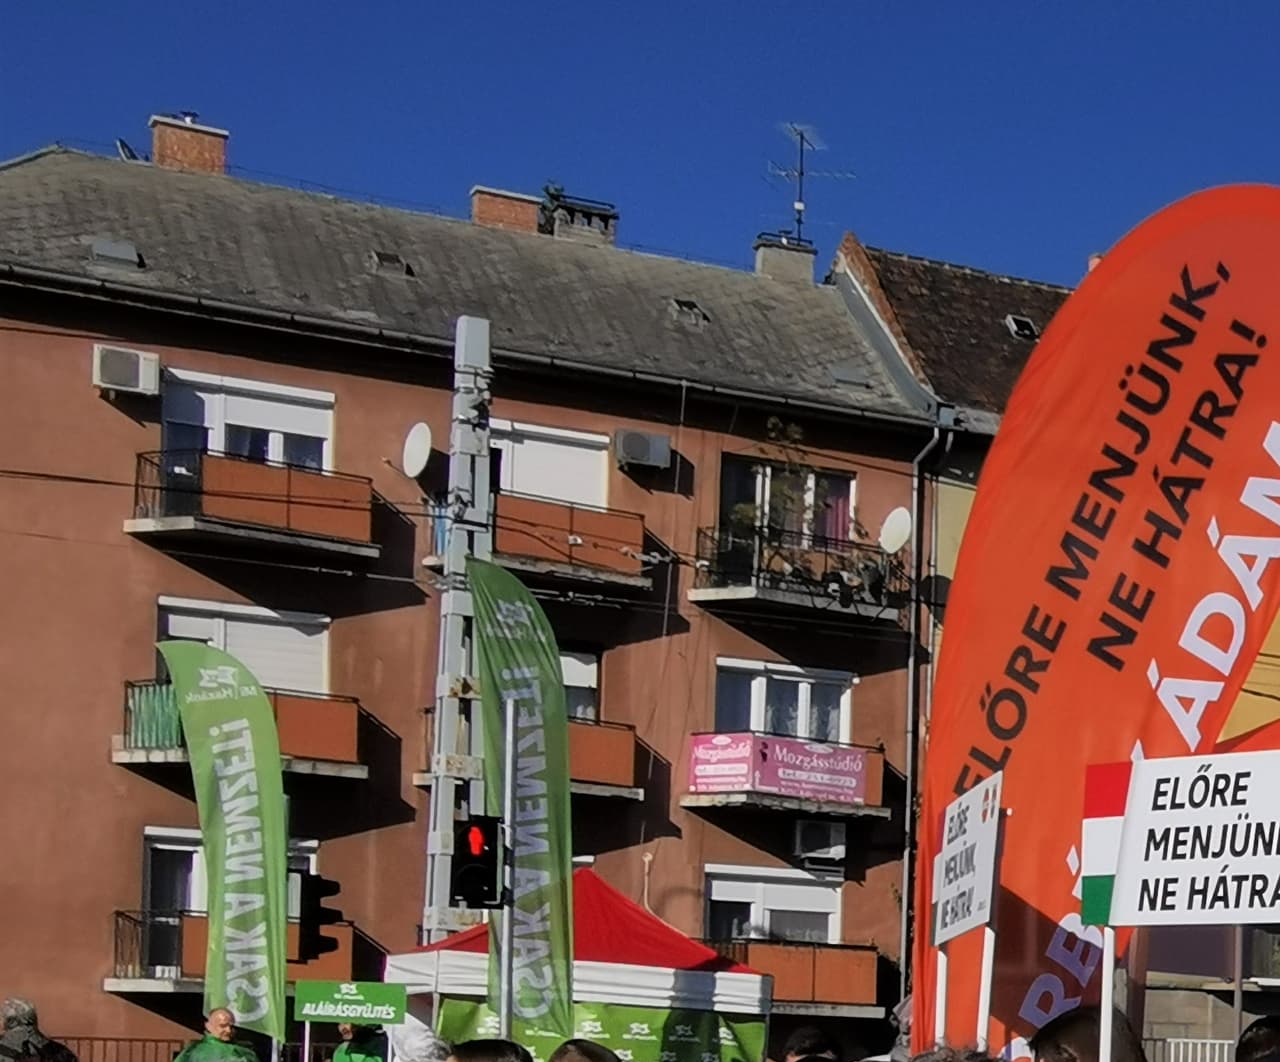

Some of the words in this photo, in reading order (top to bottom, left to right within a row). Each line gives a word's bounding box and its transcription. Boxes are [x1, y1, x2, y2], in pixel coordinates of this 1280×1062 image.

[1044, 261, 1232, 602] MENJÜNK,
[1086, 572, 1156, 673] NE
[1132, 319, 1267, 570] HÁTRA!
[775, 744, 863, 772] Mozgásstúdió
[1151, 764, 1252, 812] ELŐRE
[1138, 878, 1180, 912] NE
